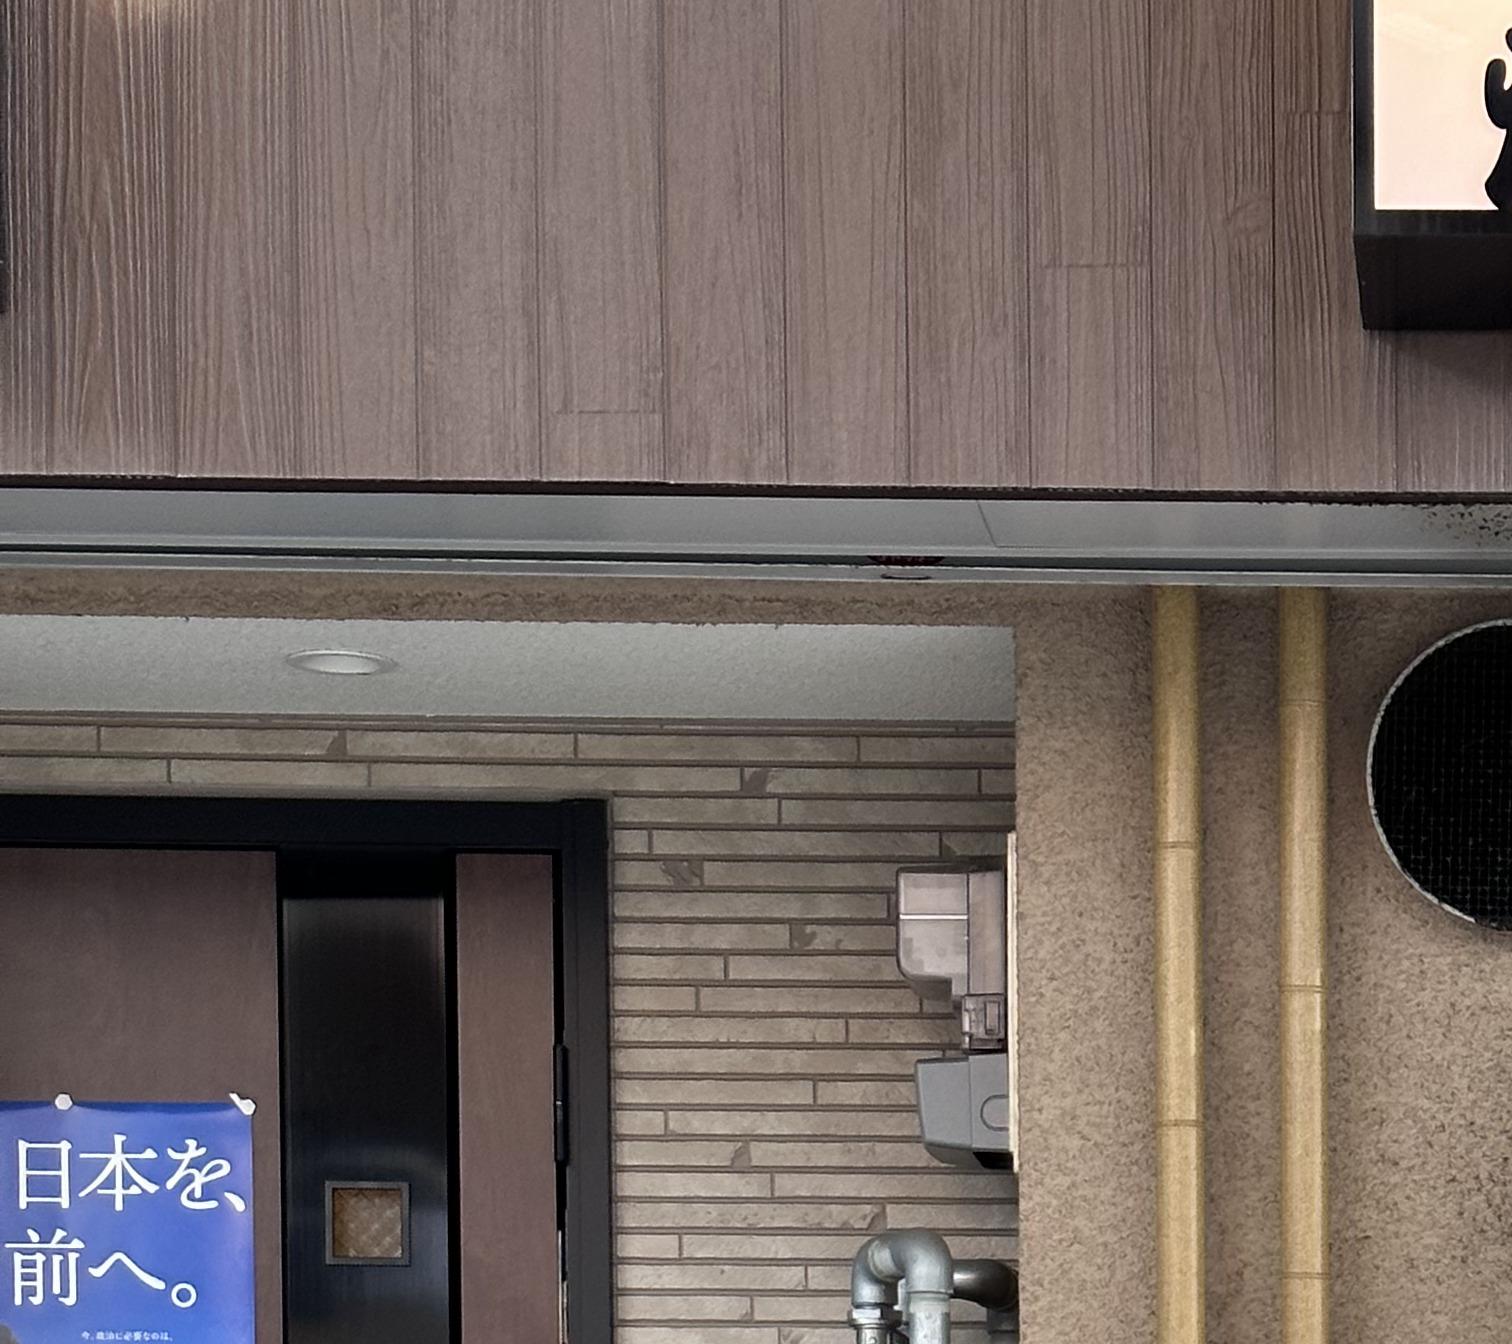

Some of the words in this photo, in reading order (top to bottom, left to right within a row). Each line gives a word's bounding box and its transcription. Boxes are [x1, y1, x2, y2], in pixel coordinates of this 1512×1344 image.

[18, 1134, 246, 1212] 日本を、
[4, 1228, 197, 1308] 前へ。
